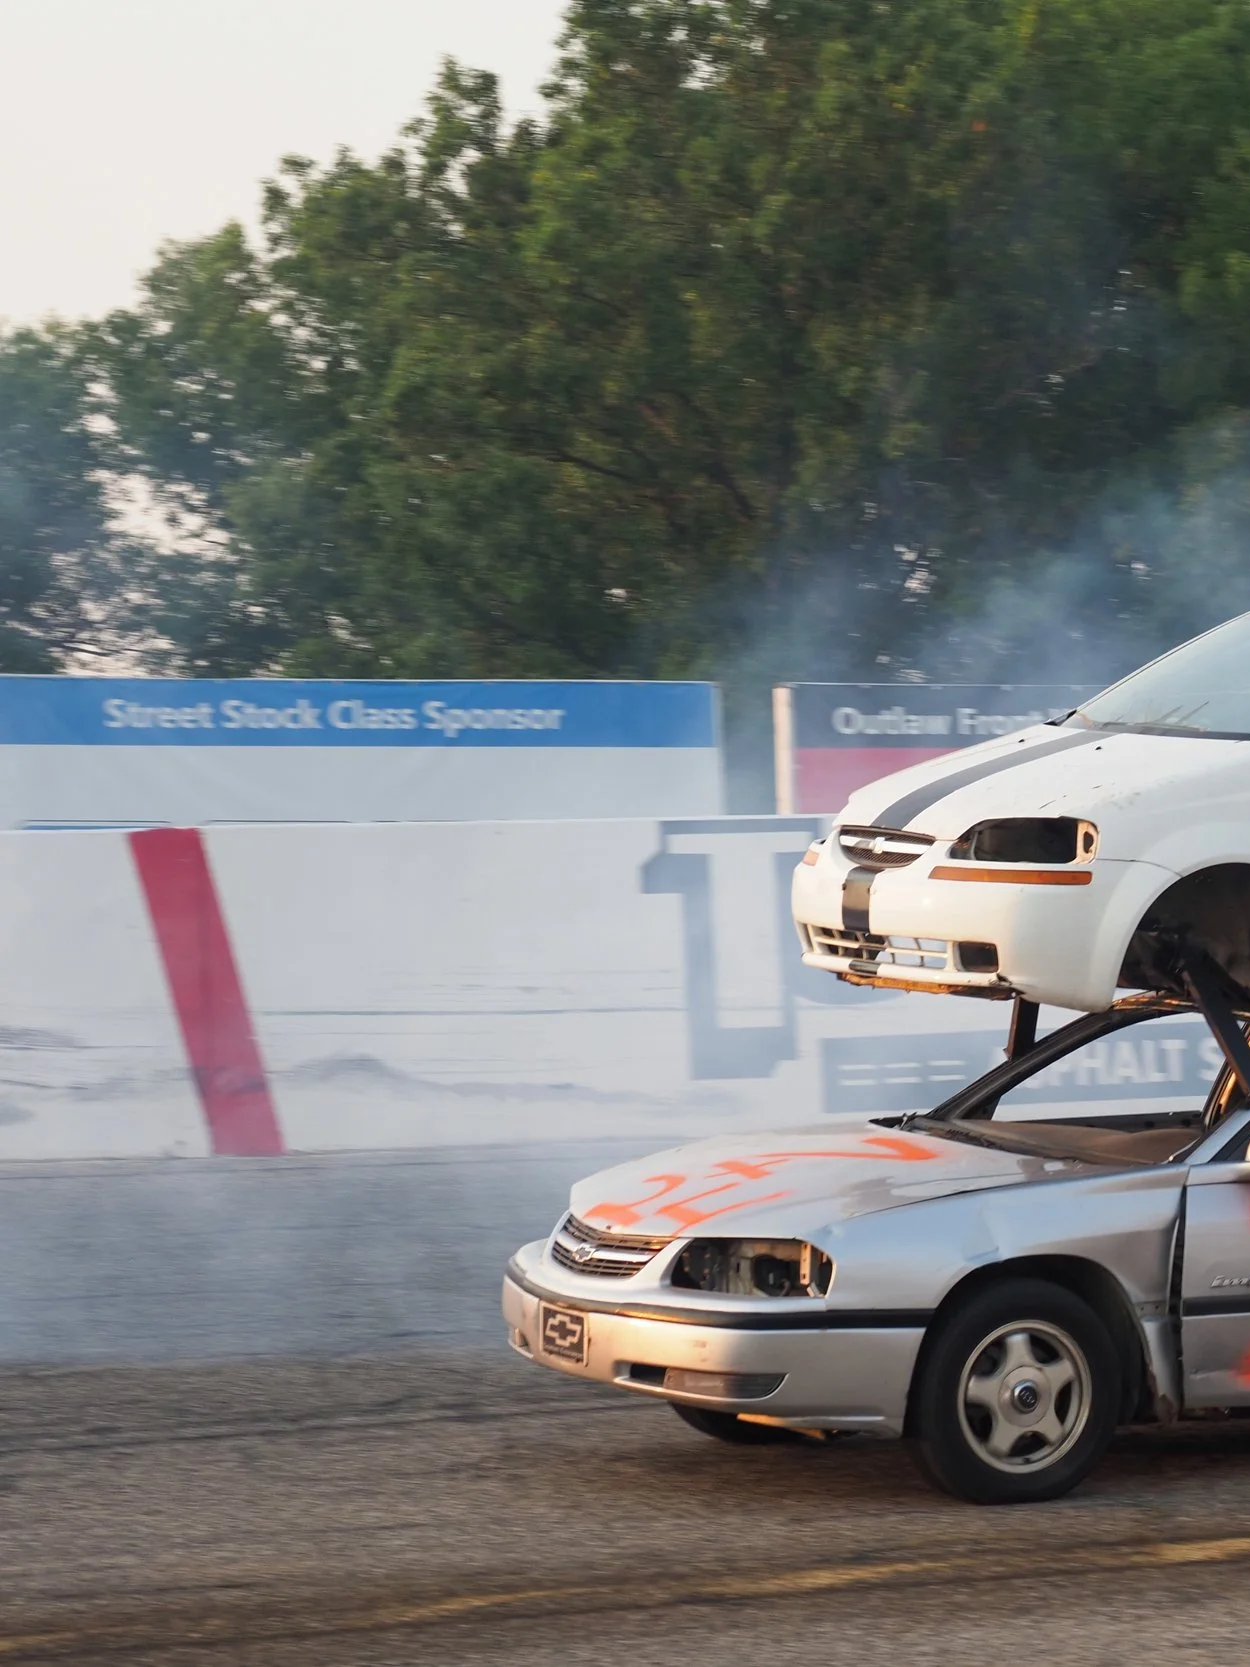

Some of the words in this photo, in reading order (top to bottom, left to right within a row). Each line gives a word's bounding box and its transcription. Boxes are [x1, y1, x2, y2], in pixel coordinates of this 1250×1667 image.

[102, 698, 216, 728] Street
[219, 699, 325, 729] Stock
[326, 699, 419, 729] Class
[421, 701, 566, 737] Sponsor
[831, 706, 951, 735] Outlaw
